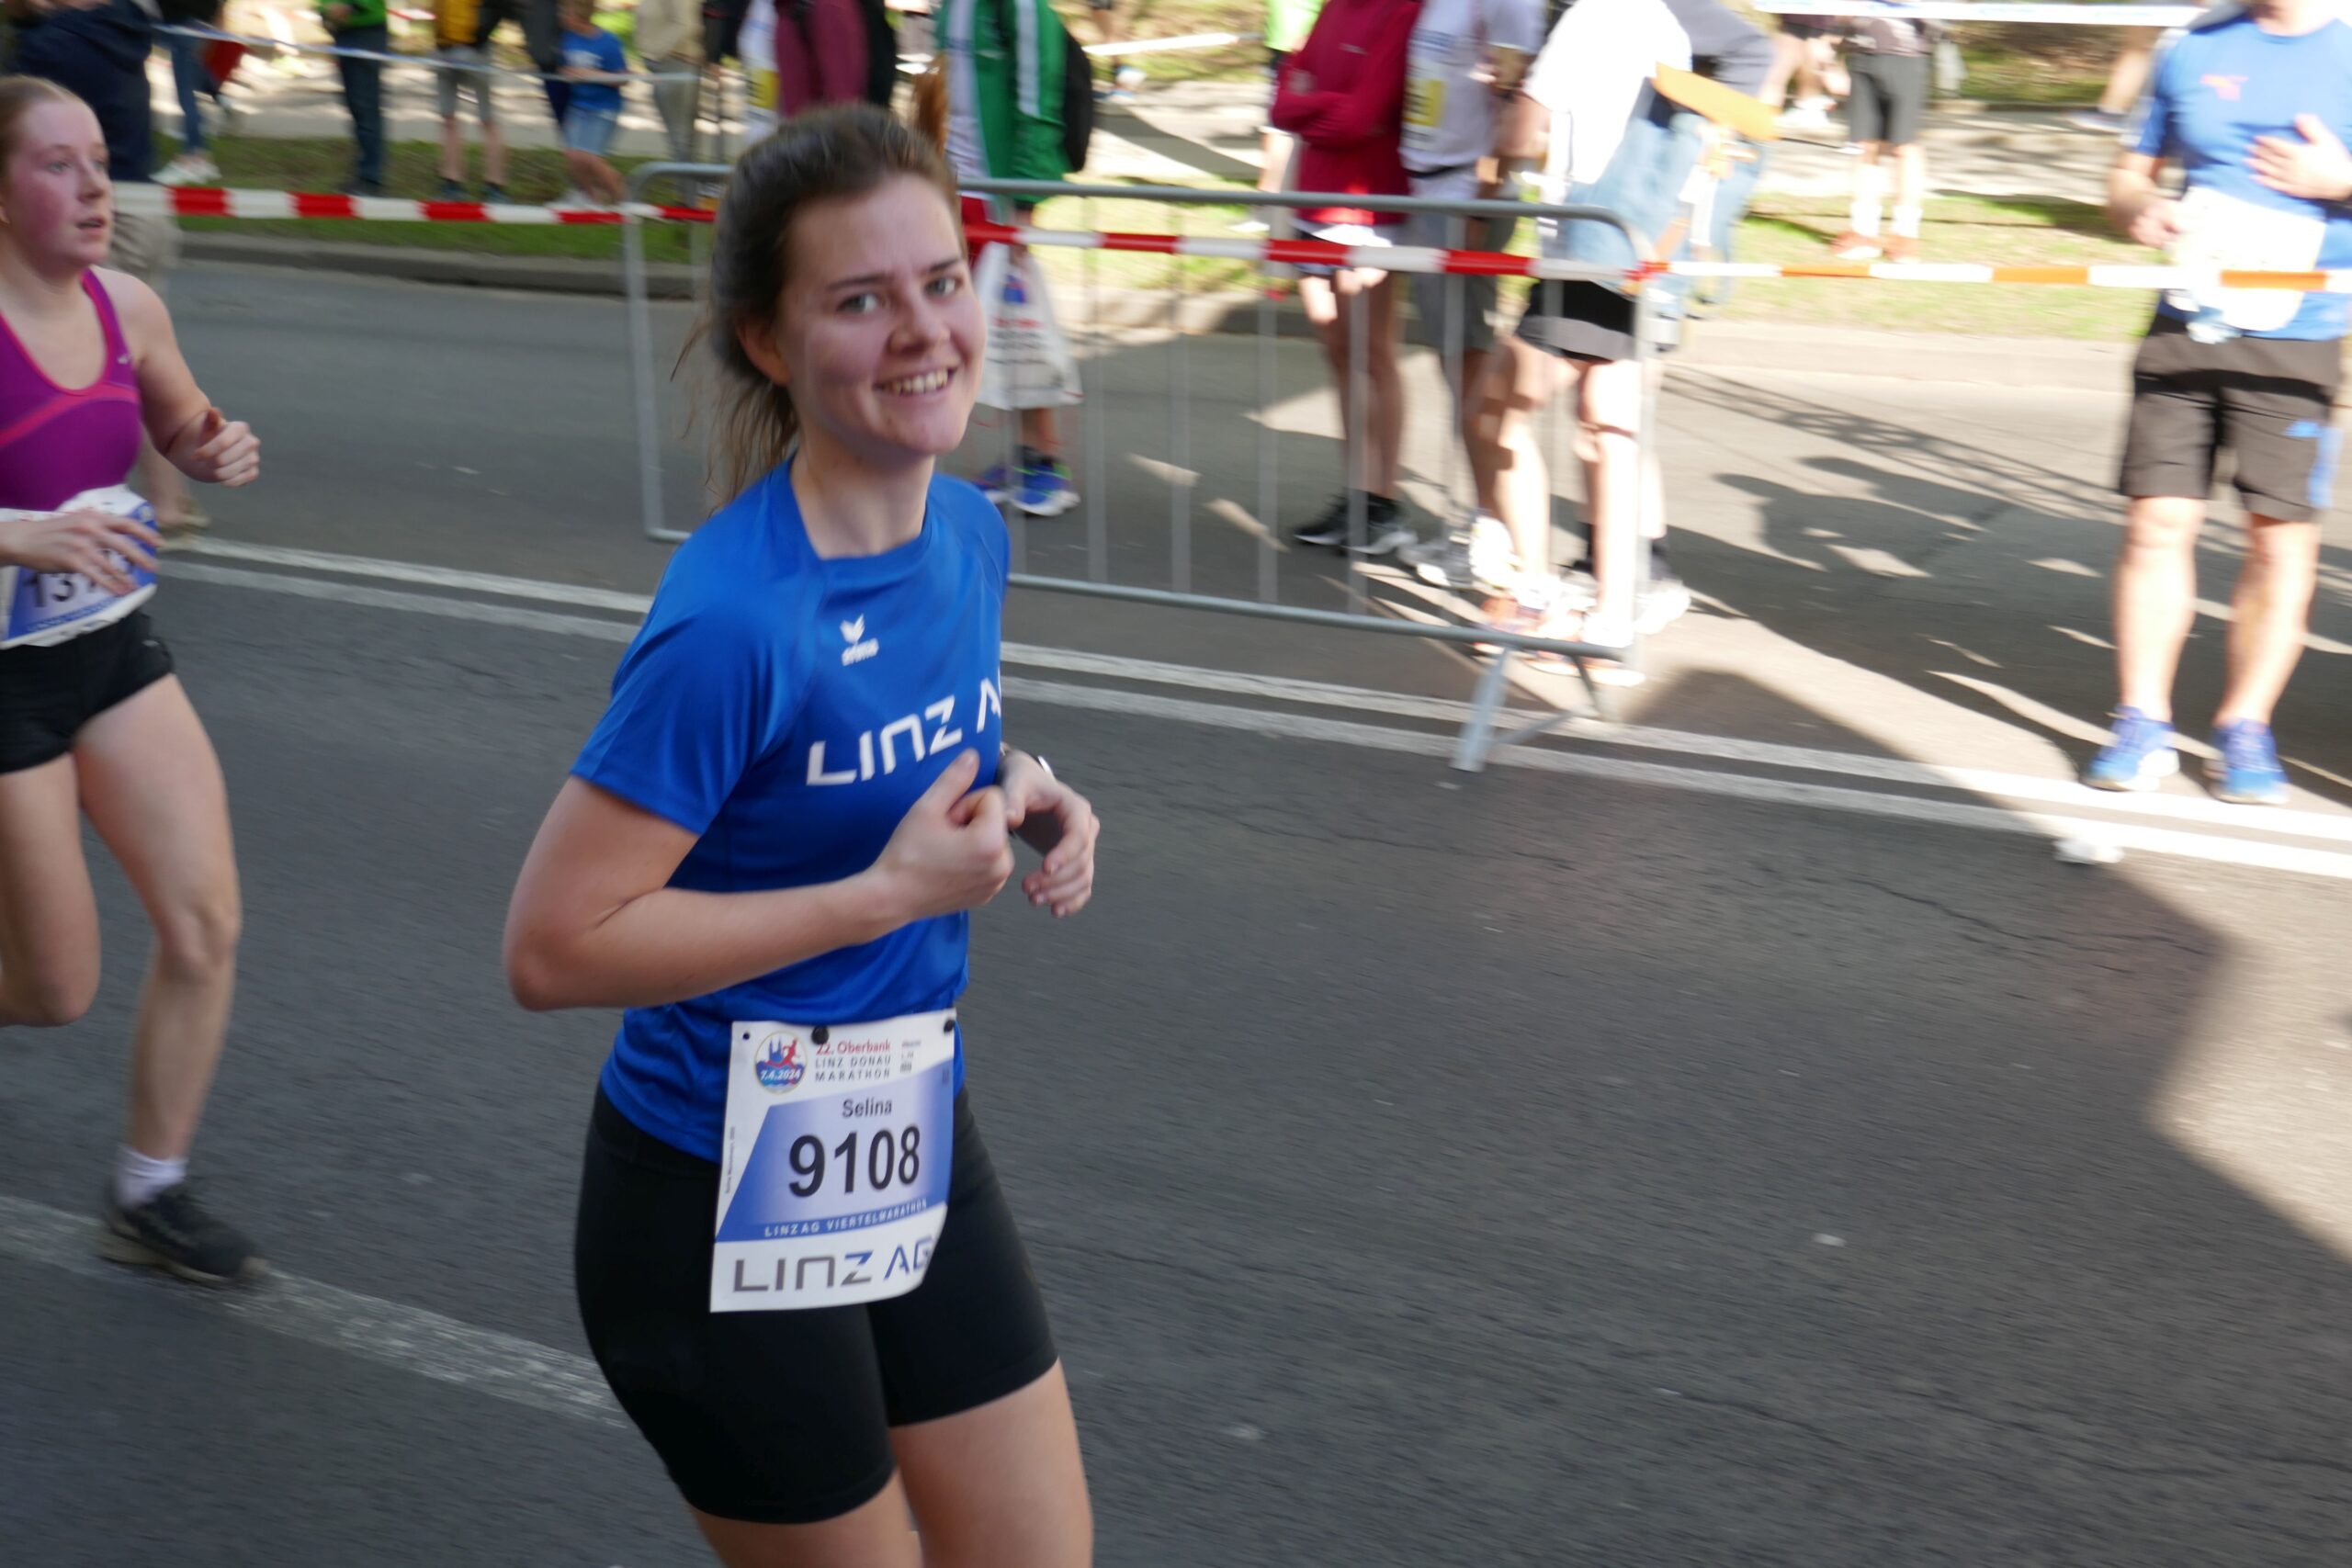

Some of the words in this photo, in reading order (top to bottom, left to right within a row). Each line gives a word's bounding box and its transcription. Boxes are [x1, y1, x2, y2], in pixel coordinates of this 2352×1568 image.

[837, 1039, 891, 1055] Oberbank
[815, 1057, 843, 1068] LINZ
[851, 1055, 891, 1067] DONAU
[761, 1068, 802, 1081] 7.4.2024
[815, 1067, 890, 1082] MARATHON
[842, 1099, 892, 1118] Selina
[788, 1123, 920, 1198] 9108
[826, 1198, 927, 1231] VIERTELMARATHON
[732, 1249, 875, 1293] LINZ
